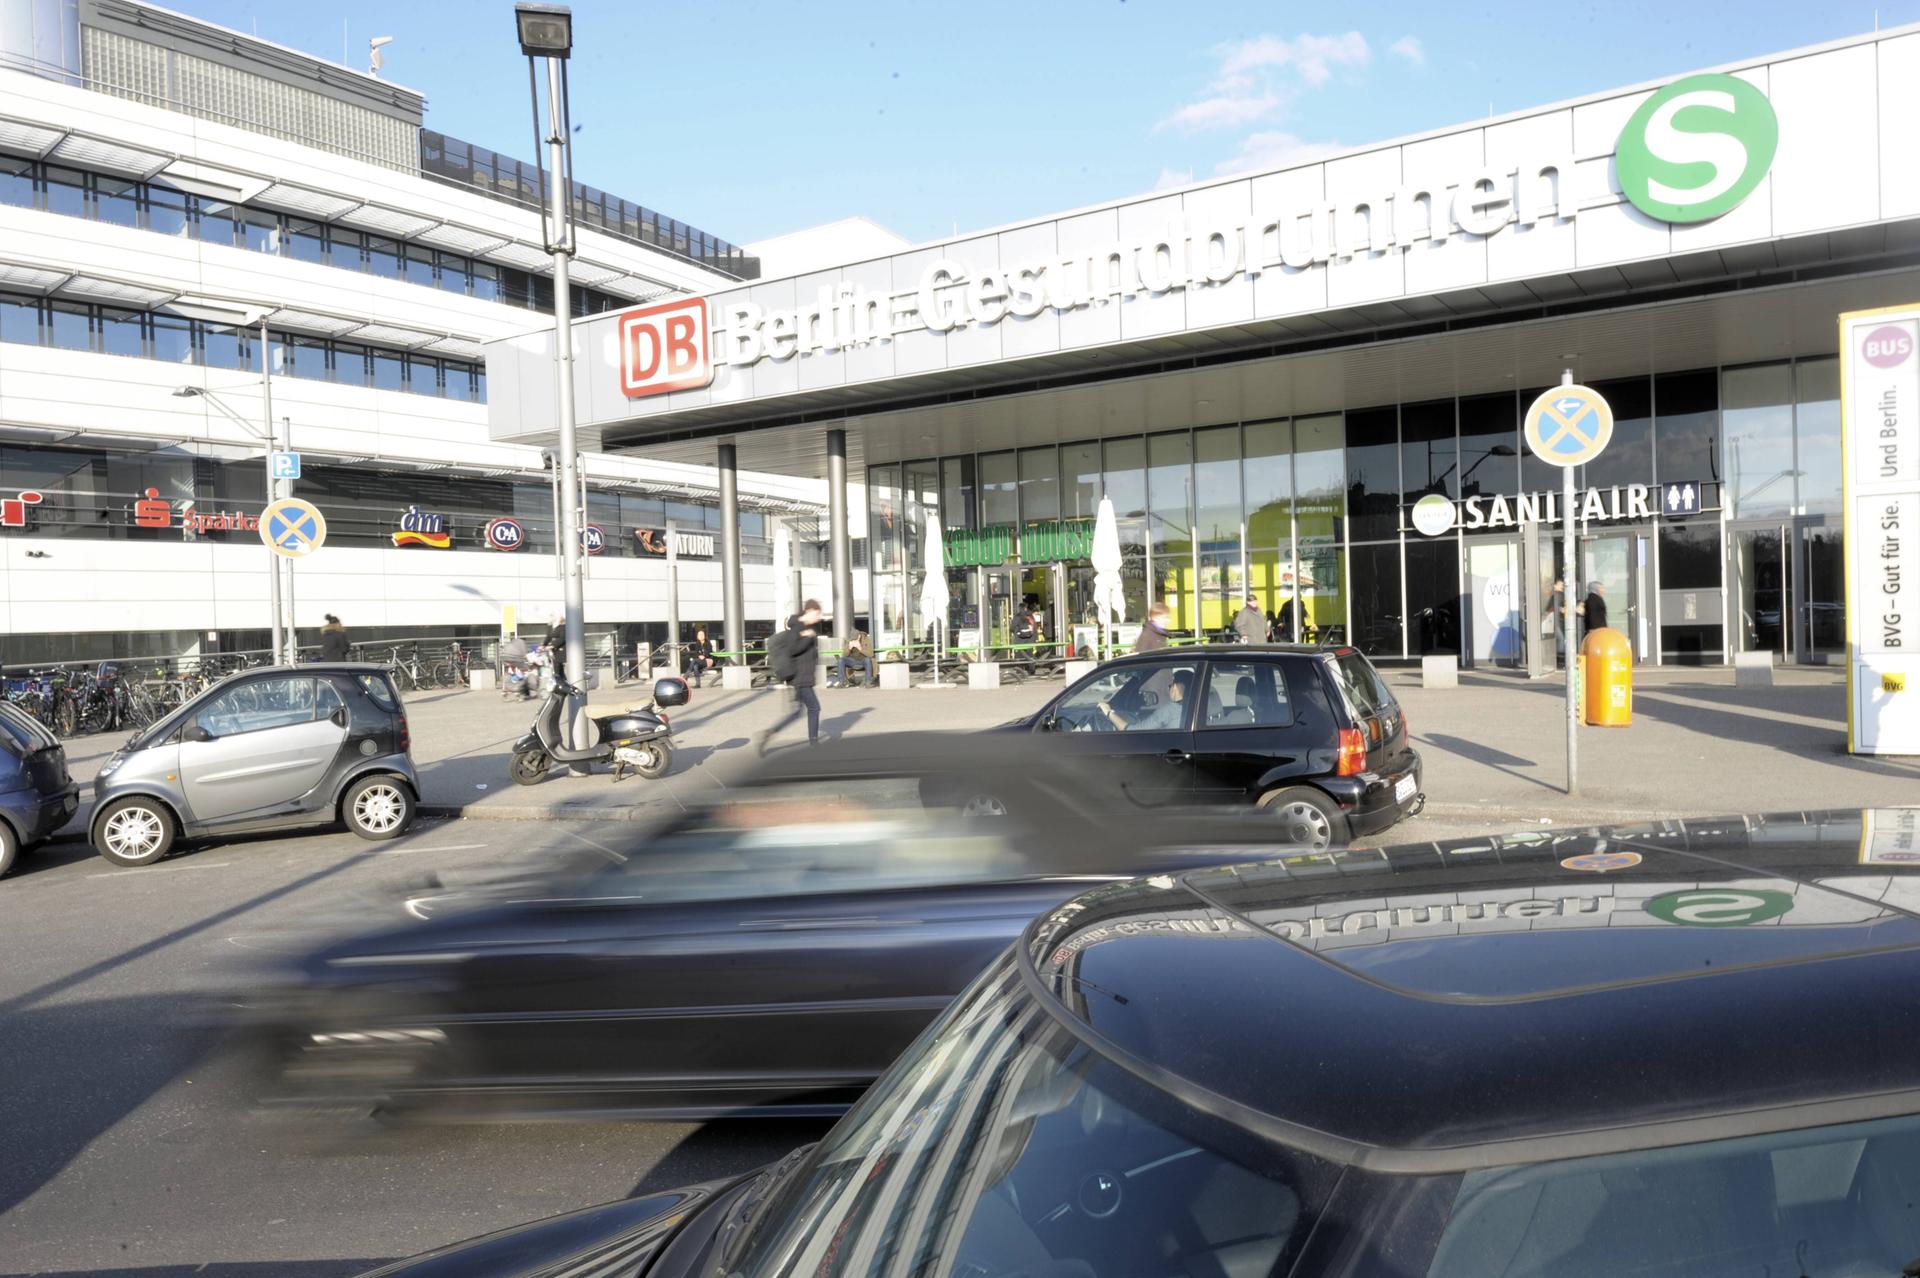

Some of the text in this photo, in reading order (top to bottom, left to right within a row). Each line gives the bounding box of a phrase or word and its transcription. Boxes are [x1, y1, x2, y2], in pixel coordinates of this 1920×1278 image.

[1644, 88, 1748, 206] S
[725, 155, 1577, 366] Berlin-Gesundbrunnen
[630, 314, 698, 382] DB
[1867, 338, 1910, 358] BUS
[1878, 384, 1898, 438] Berlin.
[275, 454, 292, 476] P
[1879, 444, 1898, 477] Und
[400, 504, 443, 532] dm
[1465, 483, 1650, 528] SANIAIR
[1881, 500, 1900, 530] Sie.
[495, 525, 518, 541] C&A
[663, 532, 714, 556] ATURN
[1881, 535, 1900, 559] für
[1883, 565, 1900, 594] Gut
[1884, 614, 1901, 648] BVG
[1883, 682, 1904, 691] BVG
